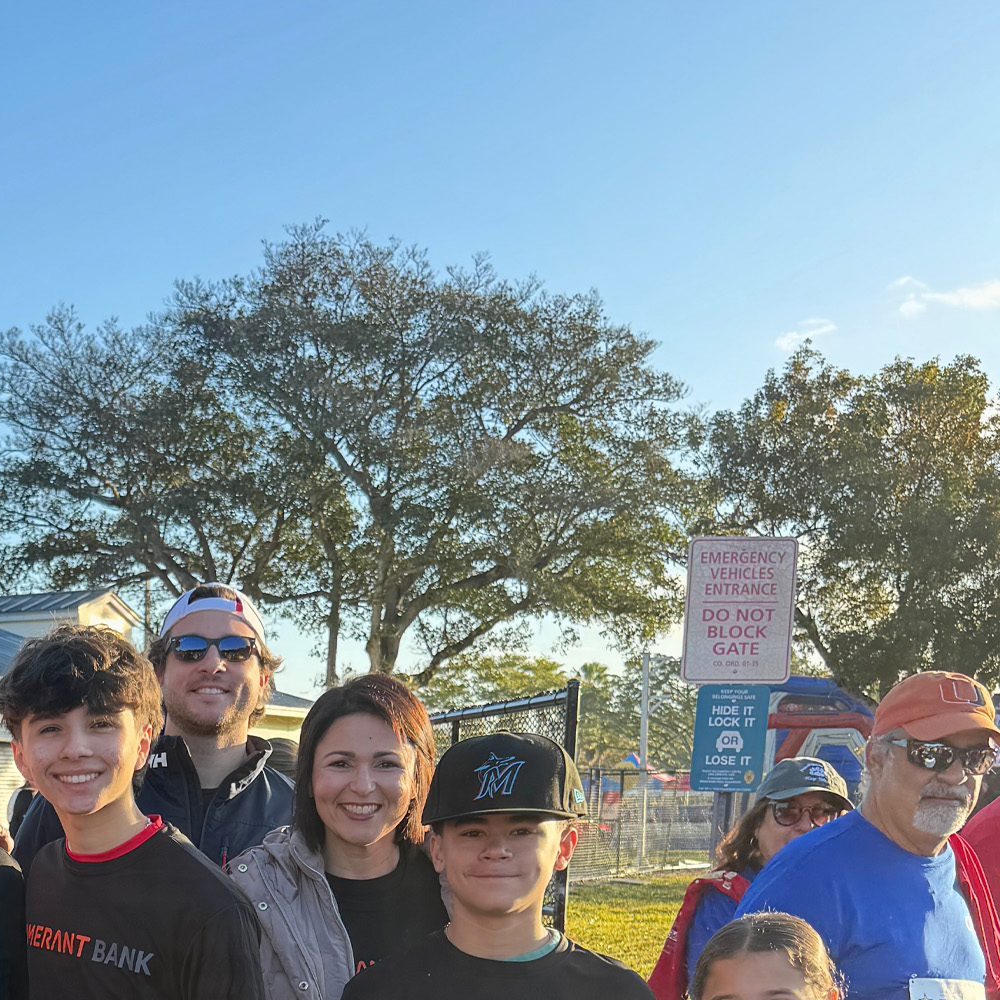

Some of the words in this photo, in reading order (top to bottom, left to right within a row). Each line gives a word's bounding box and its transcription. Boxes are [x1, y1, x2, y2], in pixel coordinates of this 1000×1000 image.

[700, 552, 786, 564] EMERGENCY
[710, 568, 774, 580] VEHICLES
[705, 584, 778, 596] ENTRANCE
[702, 608, 730, 622] DO
[736, 608, 776, 622] NOT
[707, 626, 768, 638] BLOCK
[712, 642, 760, 656] GATE
[712, 705, 739, 715] HIDE
[744, 706, 754, 716] IT
[708, 717, 740, 727] LOCK
[744, 718, 756, 727] IT
[722, 736, 738, 745] OR
[705, 755, 736, 766] LOSE
[741, 756, 752, 766] IT
[92, 939, 154, 976] BANK
